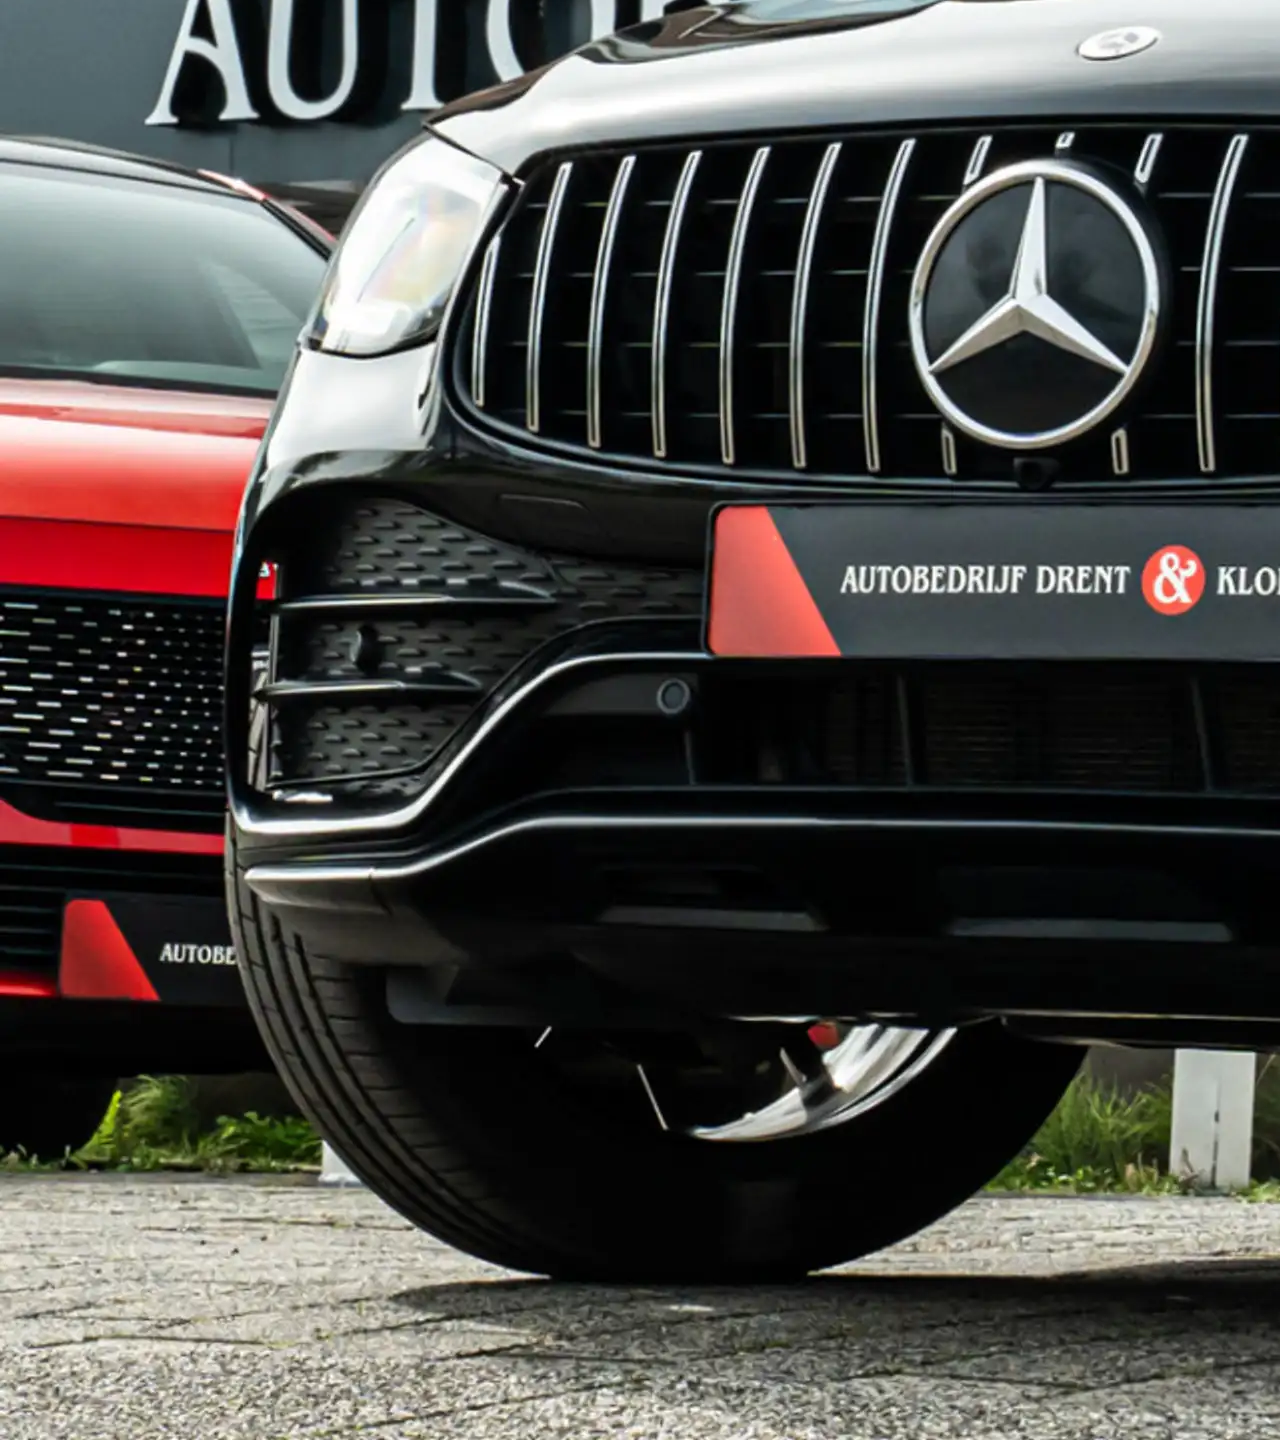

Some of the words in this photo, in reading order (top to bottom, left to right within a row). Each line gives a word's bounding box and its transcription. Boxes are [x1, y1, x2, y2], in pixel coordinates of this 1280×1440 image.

[840, 564, 1028, 595] AUTOBEDRIJF
[1036, 564, 1132, 595] DRENT
[1151, 551, 1199, 606] &
